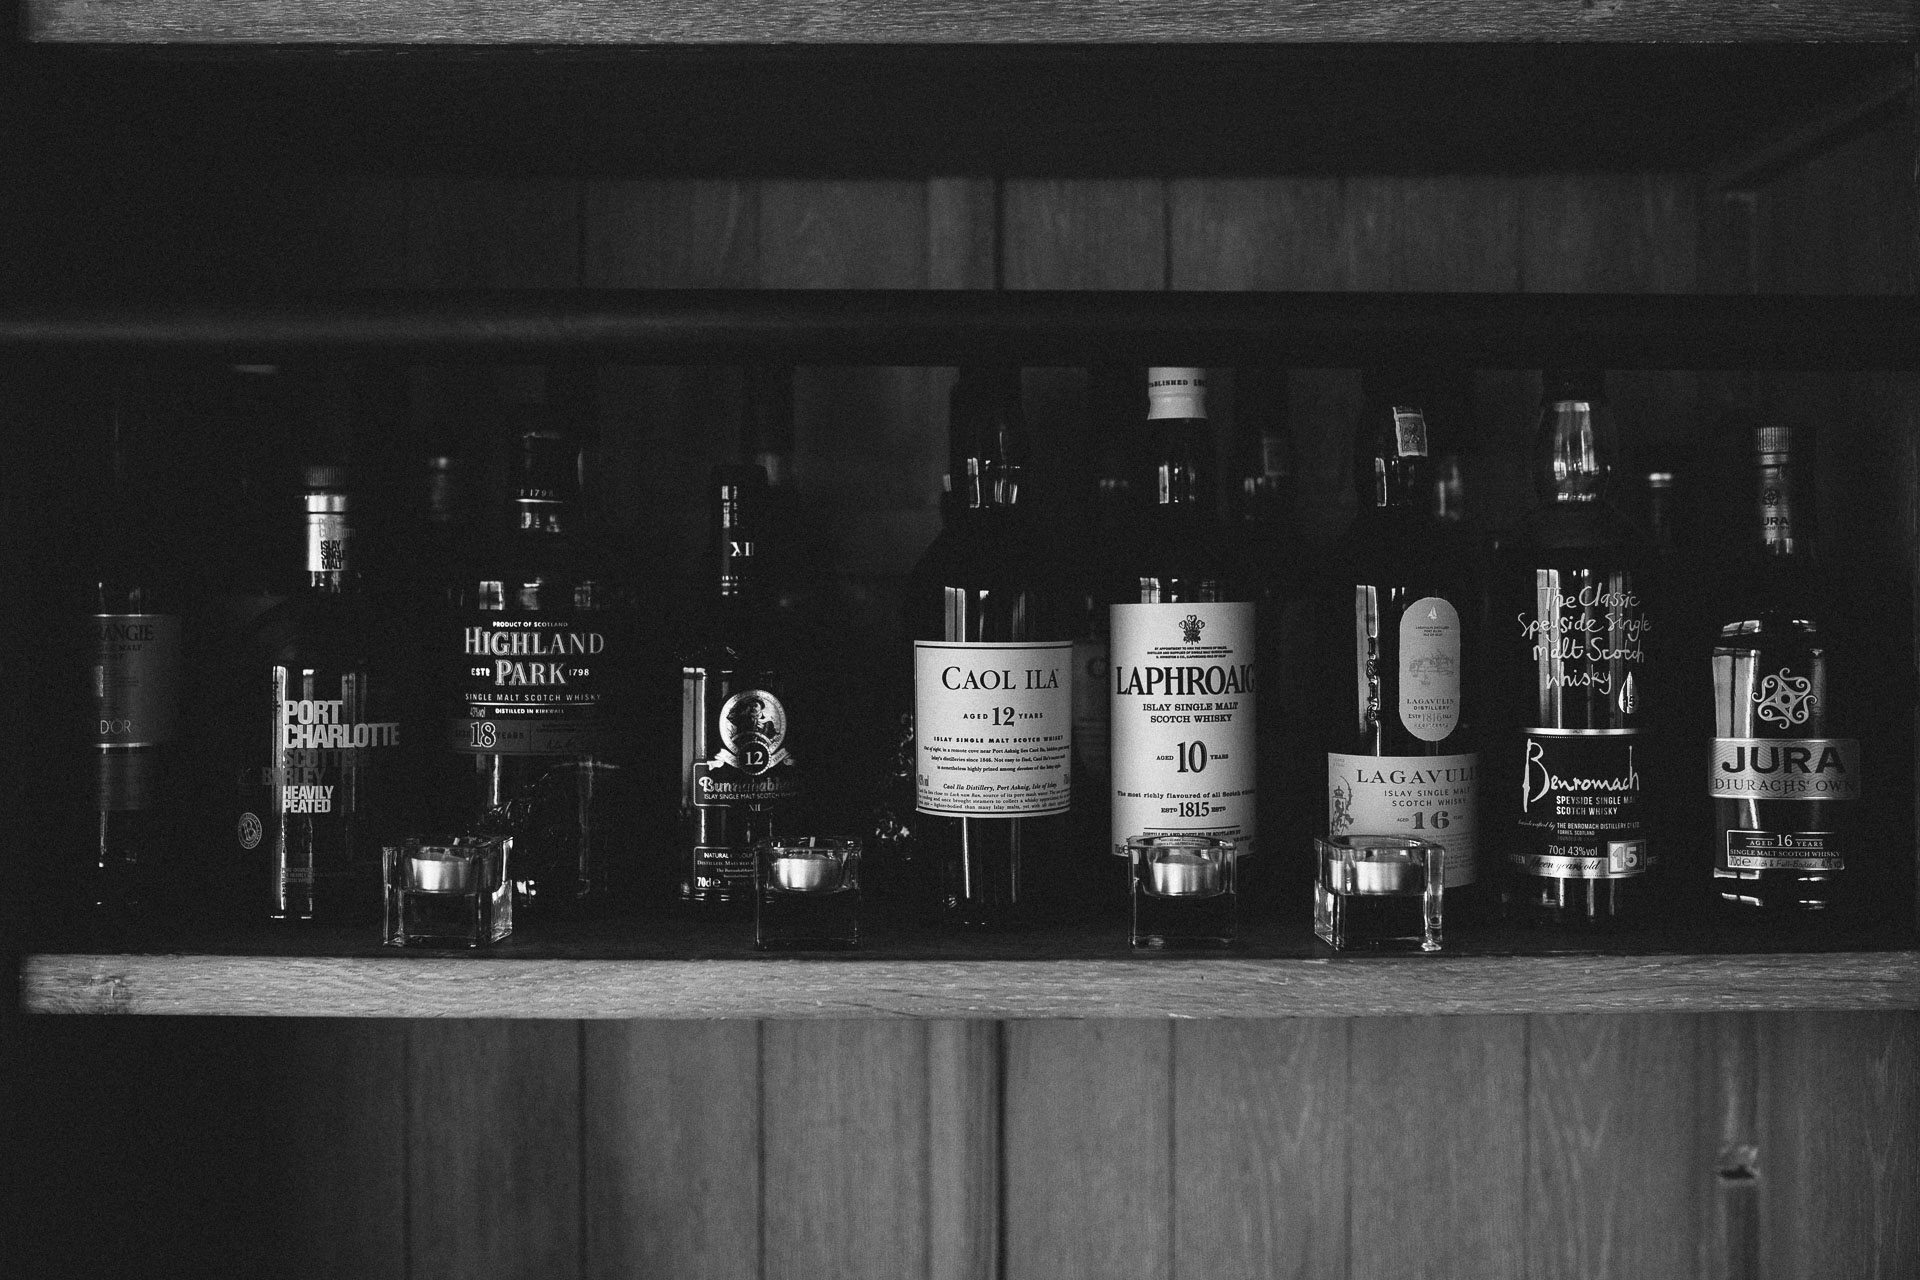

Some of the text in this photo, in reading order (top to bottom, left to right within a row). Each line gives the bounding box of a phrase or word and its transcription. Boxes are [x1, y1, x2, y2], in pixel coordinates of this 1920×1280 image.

[320, 540, 341, 550] ISLAY
[1538, 582, 1641, 611] The Classic
[492, 620, 569, 628] PRODUCT OF SCOTLAND
[1517, 612, 1652, 643] Speyside Single
[464, 626, 605, 656] HIGHLAND
[1586, 637, 1645, 664] Scotch
[495, 659, 568, 687] PARK
[568, 667, 591, 677] 1798
[941, 666, 1017, 690] CAOL
[1116, 664, 1256, 696] LAPHROAIG
[464, 692, 602, 702] SINGLE MALT SCOTCH WHISKY
[284, 700, 344, 726] PORT
[494, 707, 526, 715] DISTILLED
[526, 707, 534, 715] IN
[1142, 701, 1239, 712] ISLAY SINGLE MALT
[992, 706, 1015, 728] 12
[1150, 713, 1233, 723] SCOTCH WHISKY
[1421, 713, 1443, 723] 1816
[284, 722, 400, 749] CHARLOTTE
[470, 721, 497, 749] 18
[1043, 734, 1064, 742] WHISKY
[745, 750, 765, 766] 12
[1176, 740, 1208, 774] 10
[1721, 746, 1847, 774] JURA
[1356, 766, 1475, 784] LAGAVULI
[1522, 738, 1640, 813] Benromach
[281, 785, 335, 800] HEAVILY
[966, 784, 995, 792] Distillery,
[1011, 783, 1031, 791] Askaig,
[1417, 788, 1449, 796] SINGLE
[1453, 786, 1470, 795] MALT
[1143, 792, 1164, 800] richly
[1391, 798, 1467, 807] SCOTCH WHISKY
[1556, 795, 1622, 805] SPEYSIDE SINGLE
[281, 799, 332, 814] PEATED
[1179, 801, 1210, 817] 1815
[1556, 806, 1618, 815] SCOTCH WHISKY
[1412, 811, 1450, 830] 16
[1600, 822, 1626, 830] DISTILLERY
[1777, 834, 1793, 847] 16
[1548, 844, 1598, 857] 70cl 43%vol
[1611, 847, 1638, 868] 15
[1729, 849, 1841, 858] SINGLE MALT SCOTCH WHISKY
[1583, 860, 1601, 871] old
